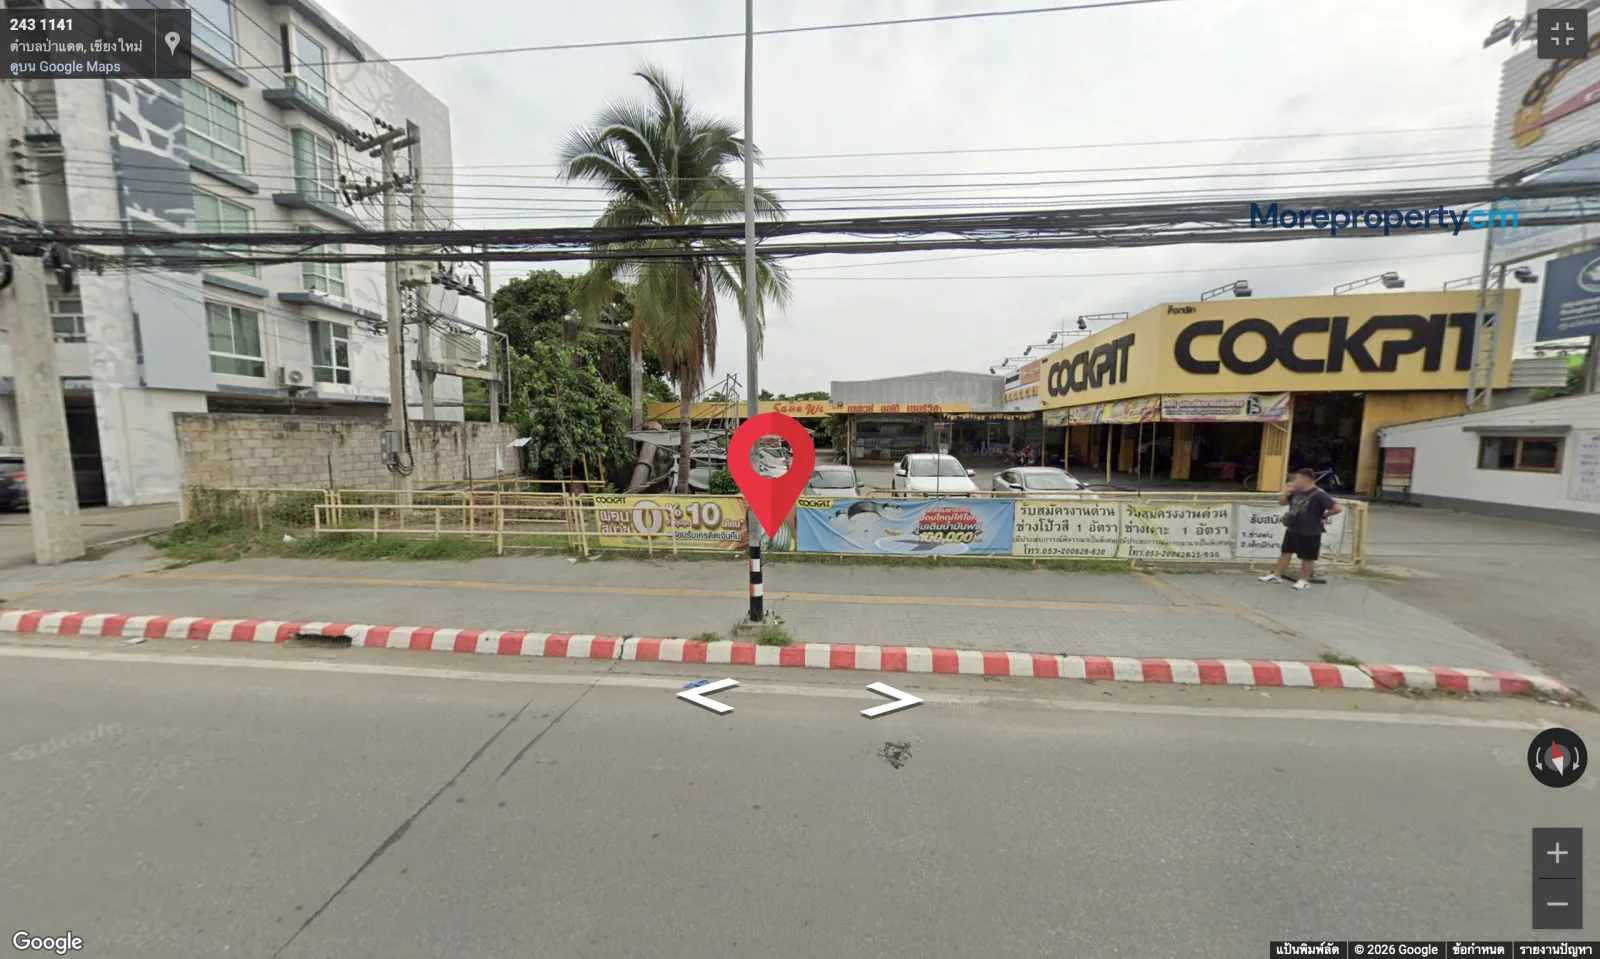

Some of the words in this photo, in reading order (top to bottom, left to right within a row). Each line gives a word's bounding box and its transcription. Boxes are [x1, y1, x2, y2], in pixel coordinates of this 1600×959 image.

[1174, 312, 1495, 376] COCKPIT
[1048, 333, 1135, 397] COCKPIT
[773, 402, 803, 413] Save
[595, 497, 626, 505] COCKPIT
[798, 500, 831, 508] COCKPIT
[686, 502, 721, 526] 10
[1020, 503, 1115, 516] รับสมัครงานด่วน
[1015, 518, 1070, 532] ช่างโป้วสี
[1076, 524, 1082, 532] 1
[1089, 520, 1118, 533] อัตรา
[1182, 526, 1188, 535] 1
[1196, 523, 1229, 535] อัตรา
